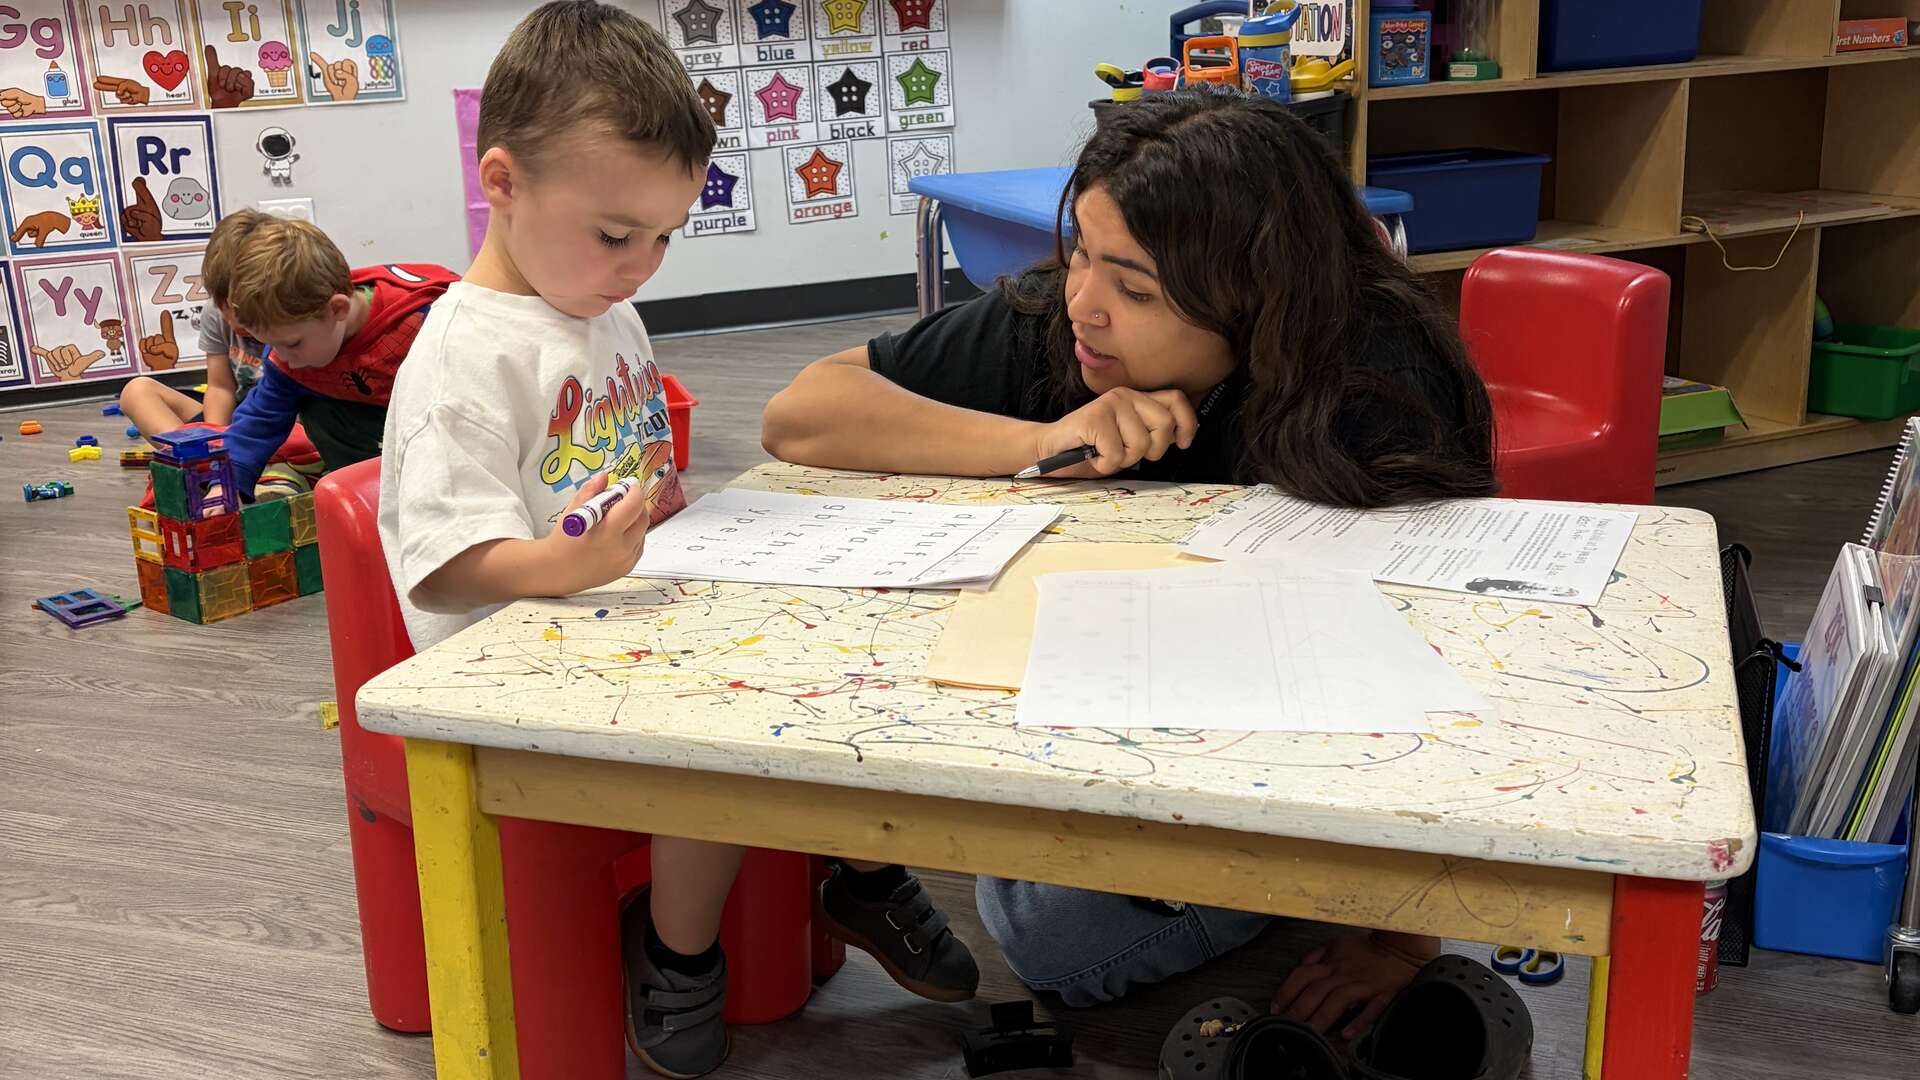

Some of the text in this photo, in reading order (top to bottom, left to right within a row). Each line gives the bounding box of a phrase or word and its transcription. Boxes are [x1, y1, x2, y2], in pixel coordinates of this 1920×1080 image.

[99, 4, 172, 47] Hh
[223, 2, 261, 42] Ii
[327, 0, 362, 47] Jj
[1289, 3, 1342, 42] TATION
[0, 5, 64, 59] Gg
[1837, 35, 1851, 46] irst
[1852, 33, 1891, 44] Numbers
[821, 40, 872, 59] yellow
[902, 34, 929, 51] red
[684, 50, 723, 67] grey
[757, 46, 795, 62] blue
[365, 81, 390, 90] jellyfish
[62, 97, 78, 106] glue
[900, 111, 945, 129] green
[766, 126, 800, 144] pink
[830, 121, 876, 139] black
[136, 135, 191, 175] Rr
[9, 146, 94, 195] Qq
[794, 200, 853, 220] orange
[693, 214, 747, 234] purple
[39, 276, 103, 325] Yy
